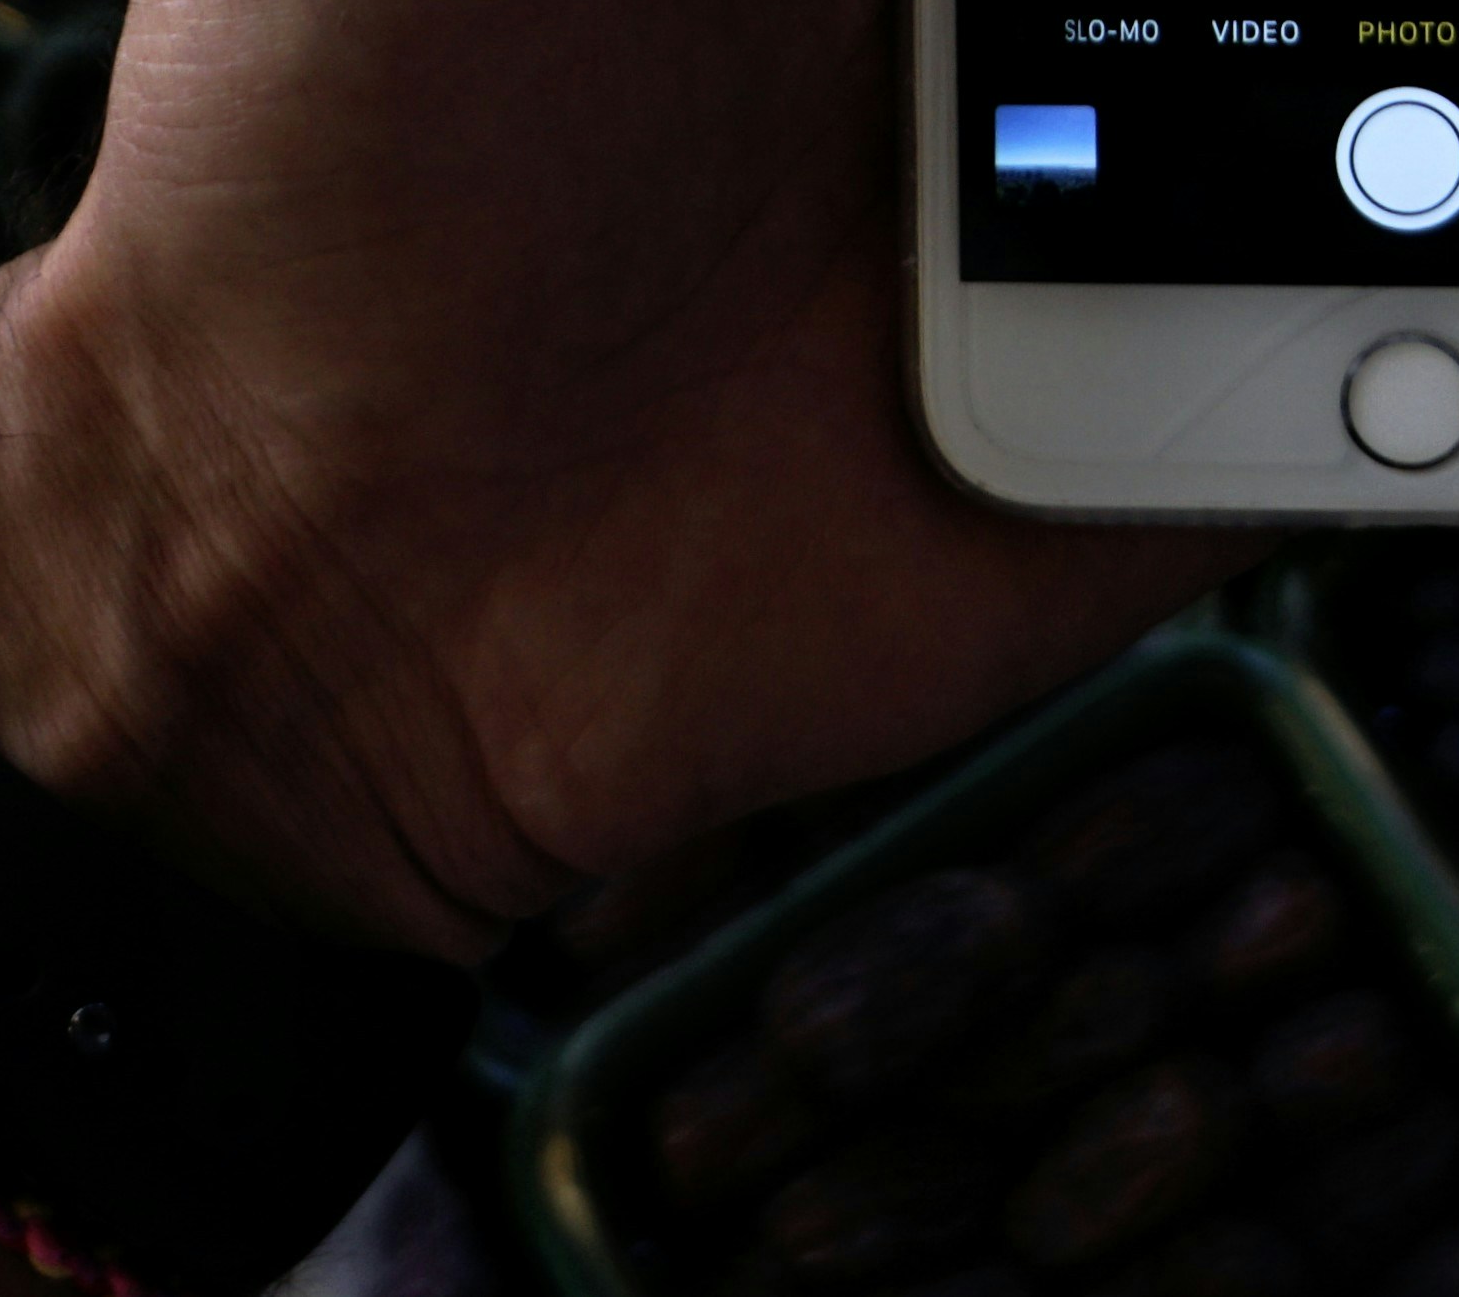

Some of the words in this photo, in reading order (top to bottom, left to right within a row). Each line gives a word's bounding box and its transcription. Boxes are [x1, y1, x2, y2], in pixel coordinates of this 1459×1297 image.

[1064, 18, 1160, 44] SLO-MO
[1211, 19, 1301, 44] VIDEO
[1358, 20, 1457, 45] PHOTO
